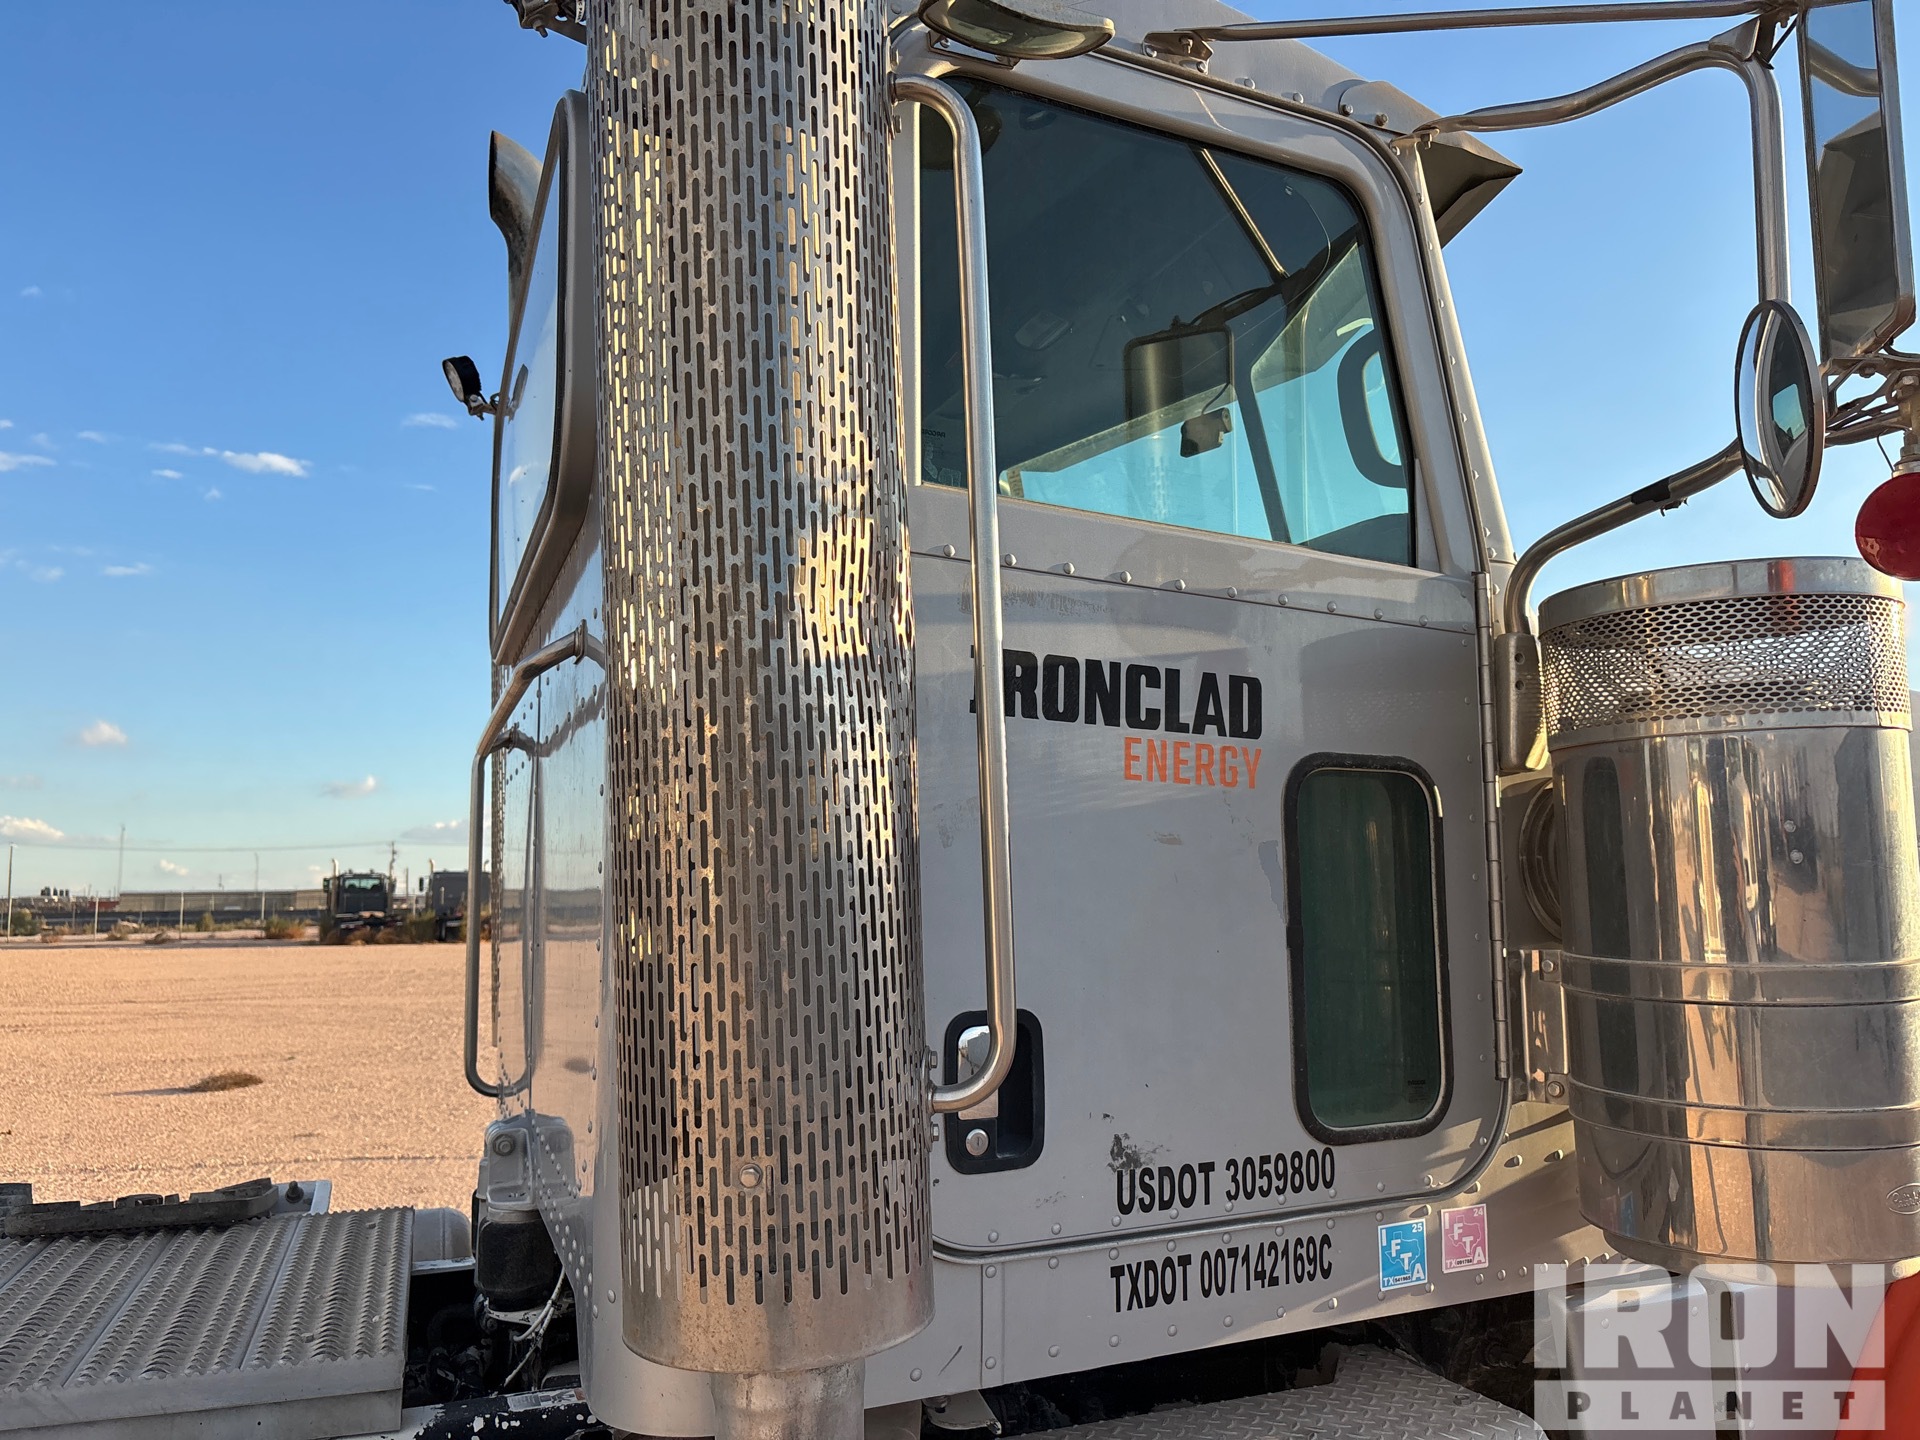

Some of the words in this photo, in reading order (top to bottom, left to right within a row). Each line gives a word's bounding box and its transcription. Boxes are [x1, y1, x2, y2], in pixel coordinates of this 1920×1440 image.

[969, 644, 1263, 740] RONCLAD
[1123, 736, 1262, 790] ENERGY
[1116, 1161, 1216, 1215] USDOT
[1224, 1147, 1336, 1202] 3059800
[1411, 1223, 1423, 1233] 25
[1473, 1207, 1484, 1217] 24
[1110, 1253, 1192, 1313] TXDOT
[1199, 1233, 1333, 1298] 007142169C
[1383, 1276, 1395, 1287] TX
